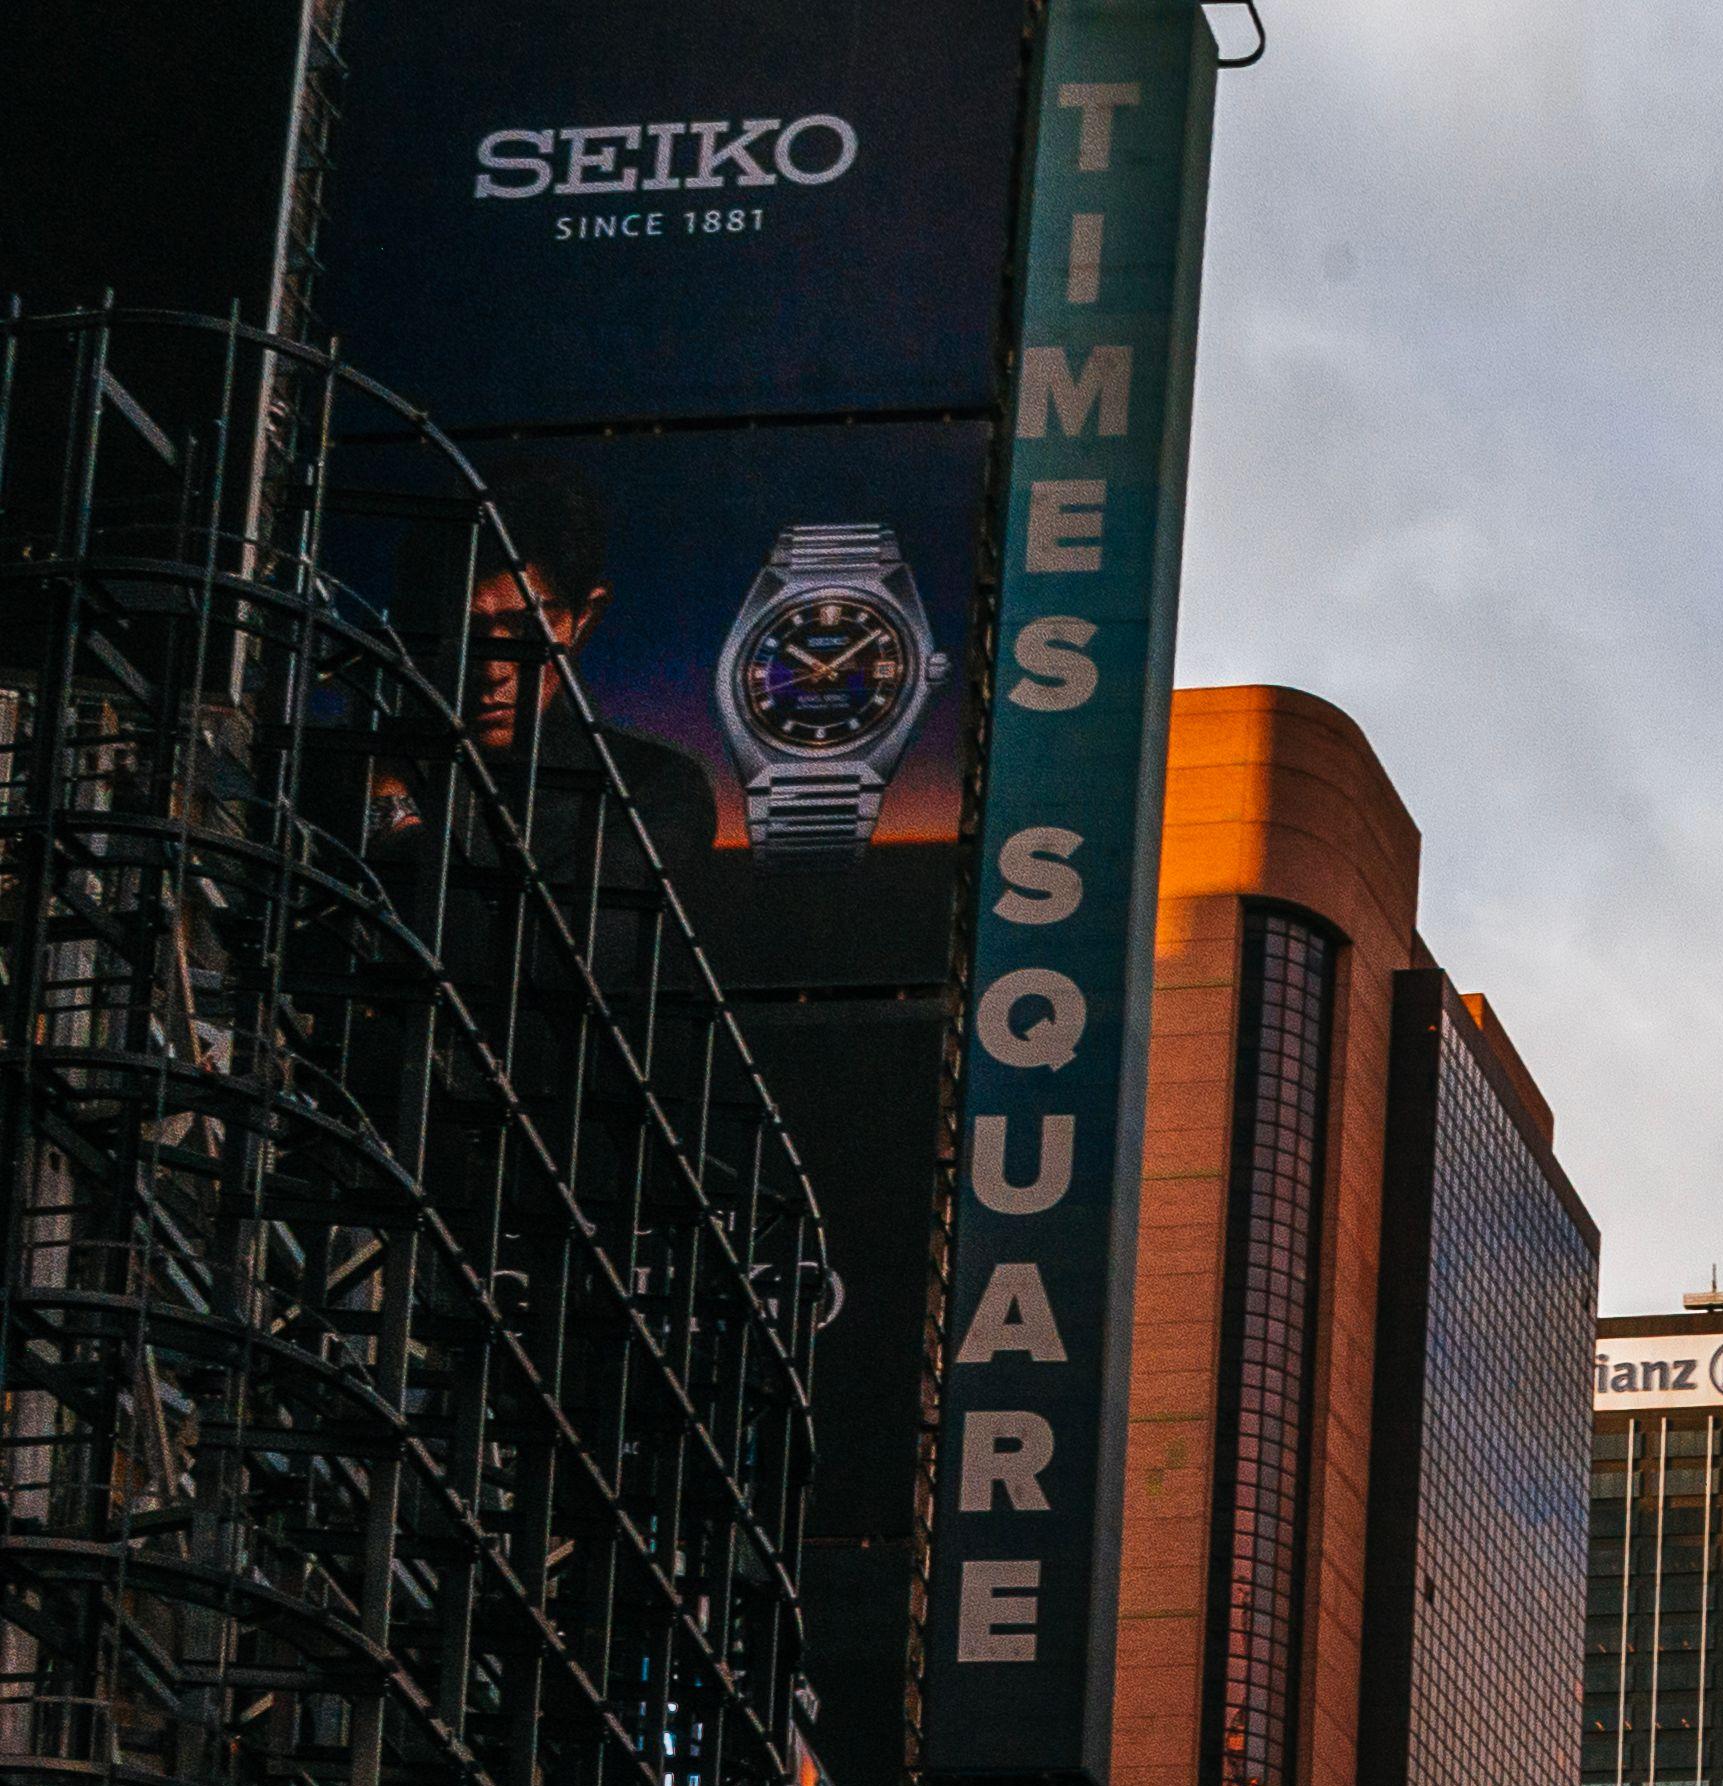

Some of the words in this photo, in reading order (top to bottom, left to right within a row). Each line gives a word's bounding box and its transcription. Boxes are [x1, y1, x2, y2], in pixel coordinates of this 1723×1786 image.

[474, 114, 859, 199] SEIKO
[555, 210, 664, 241] SINCE
[684, 208, 766, 236] 1881
[1009, 82, 1142, 712] TIMES
[956, 825, 1088, 1663] SQUARE
[1594, 1354, 1698, 1395] ianz
